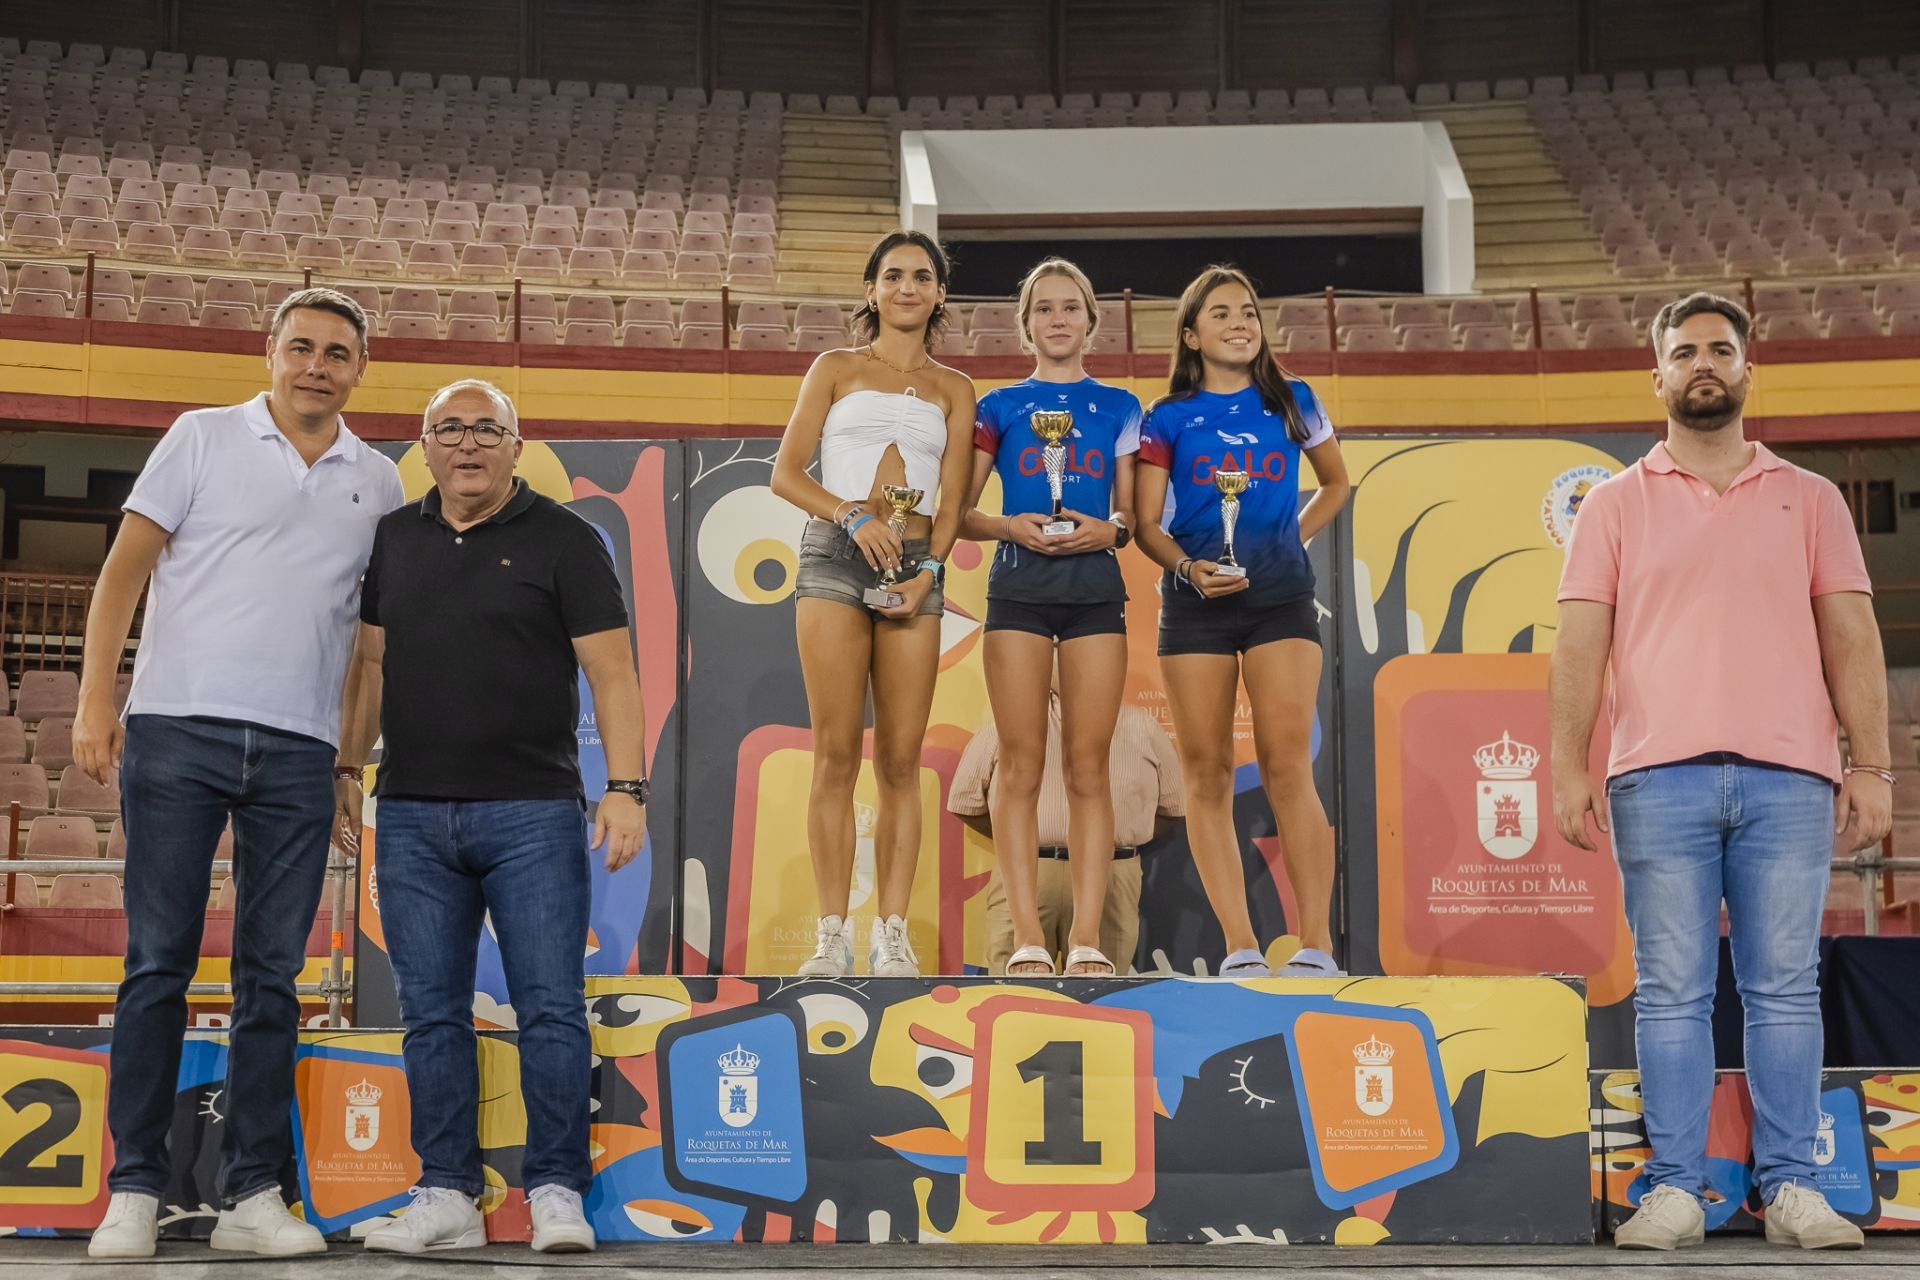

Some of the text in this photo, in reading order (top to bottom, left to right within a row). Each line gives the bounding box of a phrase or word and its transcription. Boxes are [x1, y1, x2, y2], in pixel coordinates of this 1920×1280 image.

[1018, 443, 1105, 479] GLO
[1046, 474, 1080, 484] SORT
[1457, 863, 1562, 873] AYUNTAMIENTO DE
[1431, 877, 1588, 895] ROQUETAS DE MAR
[1428, 903, 1594, 915] Área de Deportes, Cultura y Tiempo Libre
[1016, 1041, 1102, 1165] 1
[0, 1078, 84, 1188] 2
[1325, 1126, 1424, 1138] ROQUETAS DE MAR
[687, 1139, 788, 1151] ROQUETAS DE MAR
[317, 1160, 404, 1171] ROQUETAS DE MAR
